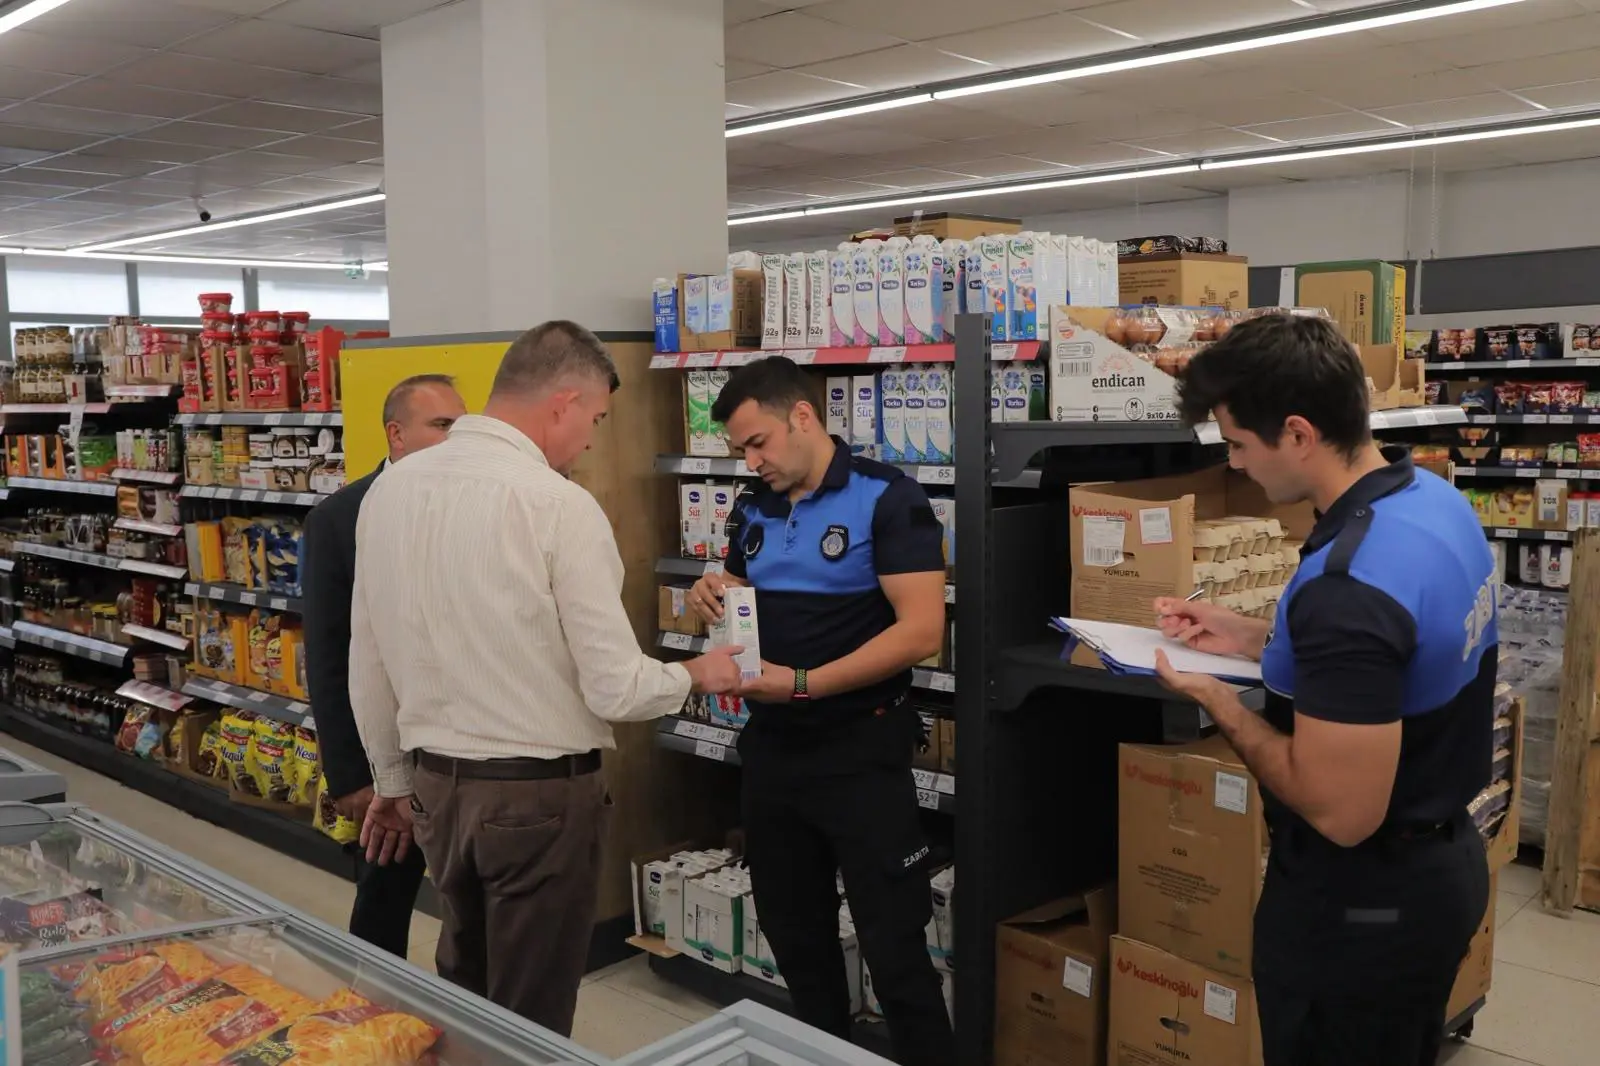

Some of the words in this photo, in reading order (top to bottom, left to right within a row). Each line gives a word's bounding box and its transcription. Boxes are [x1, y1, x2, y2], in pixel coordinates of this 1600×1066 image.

[768, 276, 777, 323] PROTEIN
[789, 275, 799, 325] PROTEIN
[812, 275, 822, 324] PROTEIN
[765, 328, 778, 336] 52g
[788, 327, 801, 336] 52g
[810, 327, 823, 335] 52g
[1092, 374, 1145, 388] endican
[1131, 401, 1137, 409] M
[830, 406, 844, 417] Süt
[857, 406, 872, 417] Süt
[938, 469, 950, 478] 65
[688, 507, 700, 517] Süt
[1103, 568, 1140, 578] YUMURTA
[918, 792, 929, 802] 52
[903, 846, 930, 868] ZABITA
[1133, 964, 1199, 999] keskinoğlu
[1154, 1042, 1190, 1060] YUMURTA
